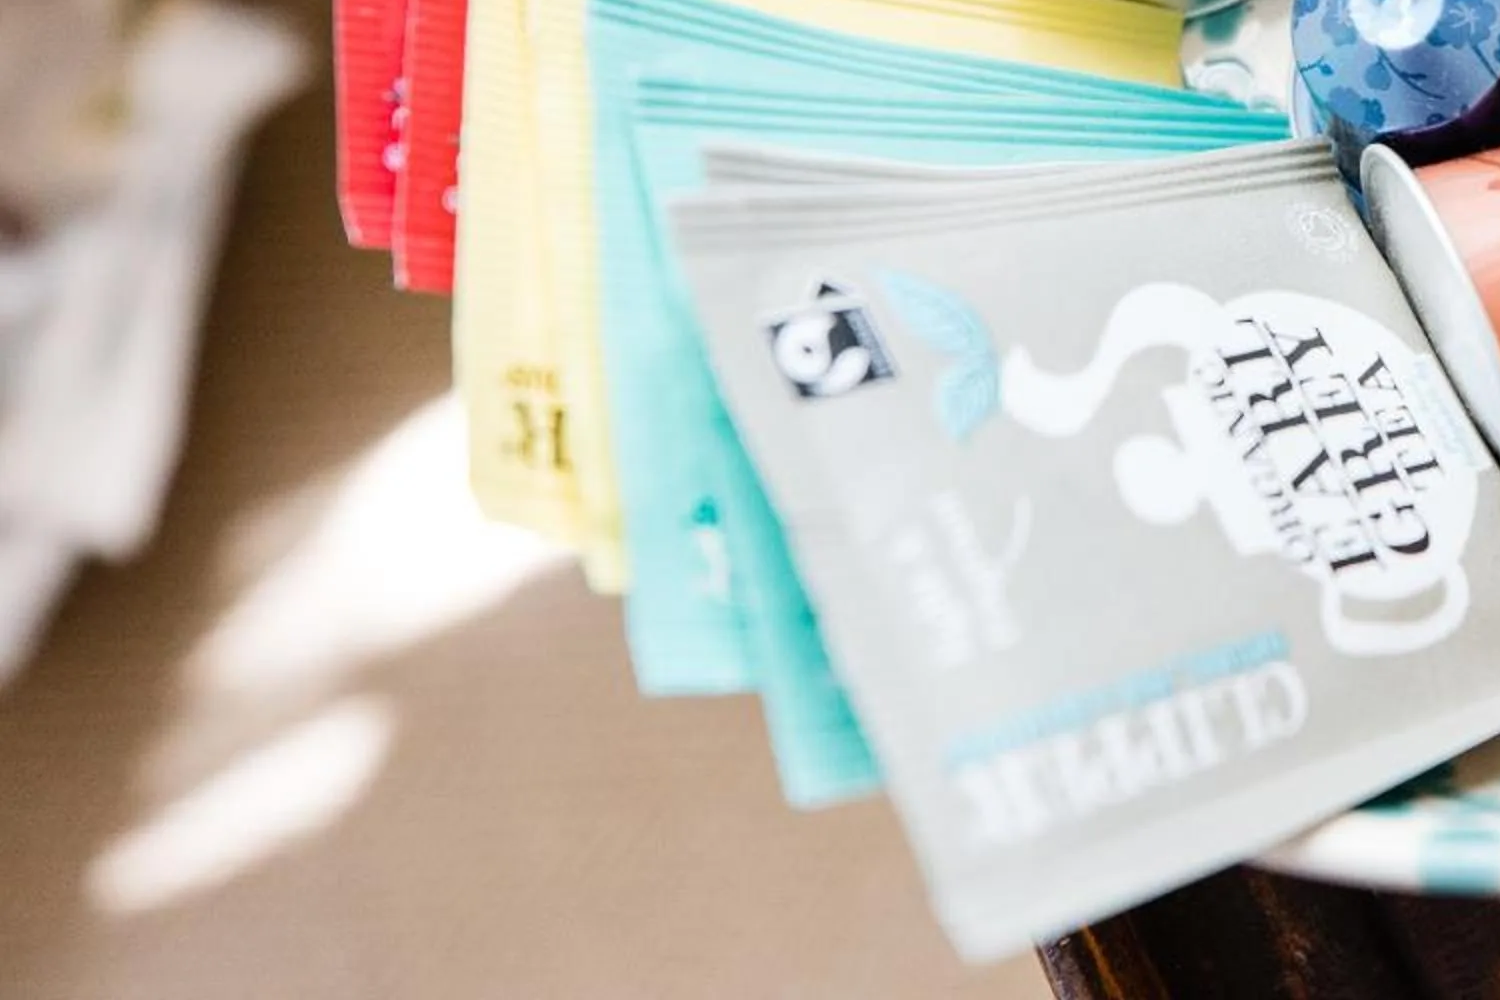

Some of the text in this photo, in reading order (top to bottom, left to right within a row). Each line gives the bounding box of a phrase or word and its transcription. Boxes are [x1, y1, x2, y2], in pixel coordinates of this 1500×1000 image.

[1217, 318, 1386, 573] EARL
[1263, 322, 1430, 554] GREY
[1357, 351, 1444, 493] TEA
